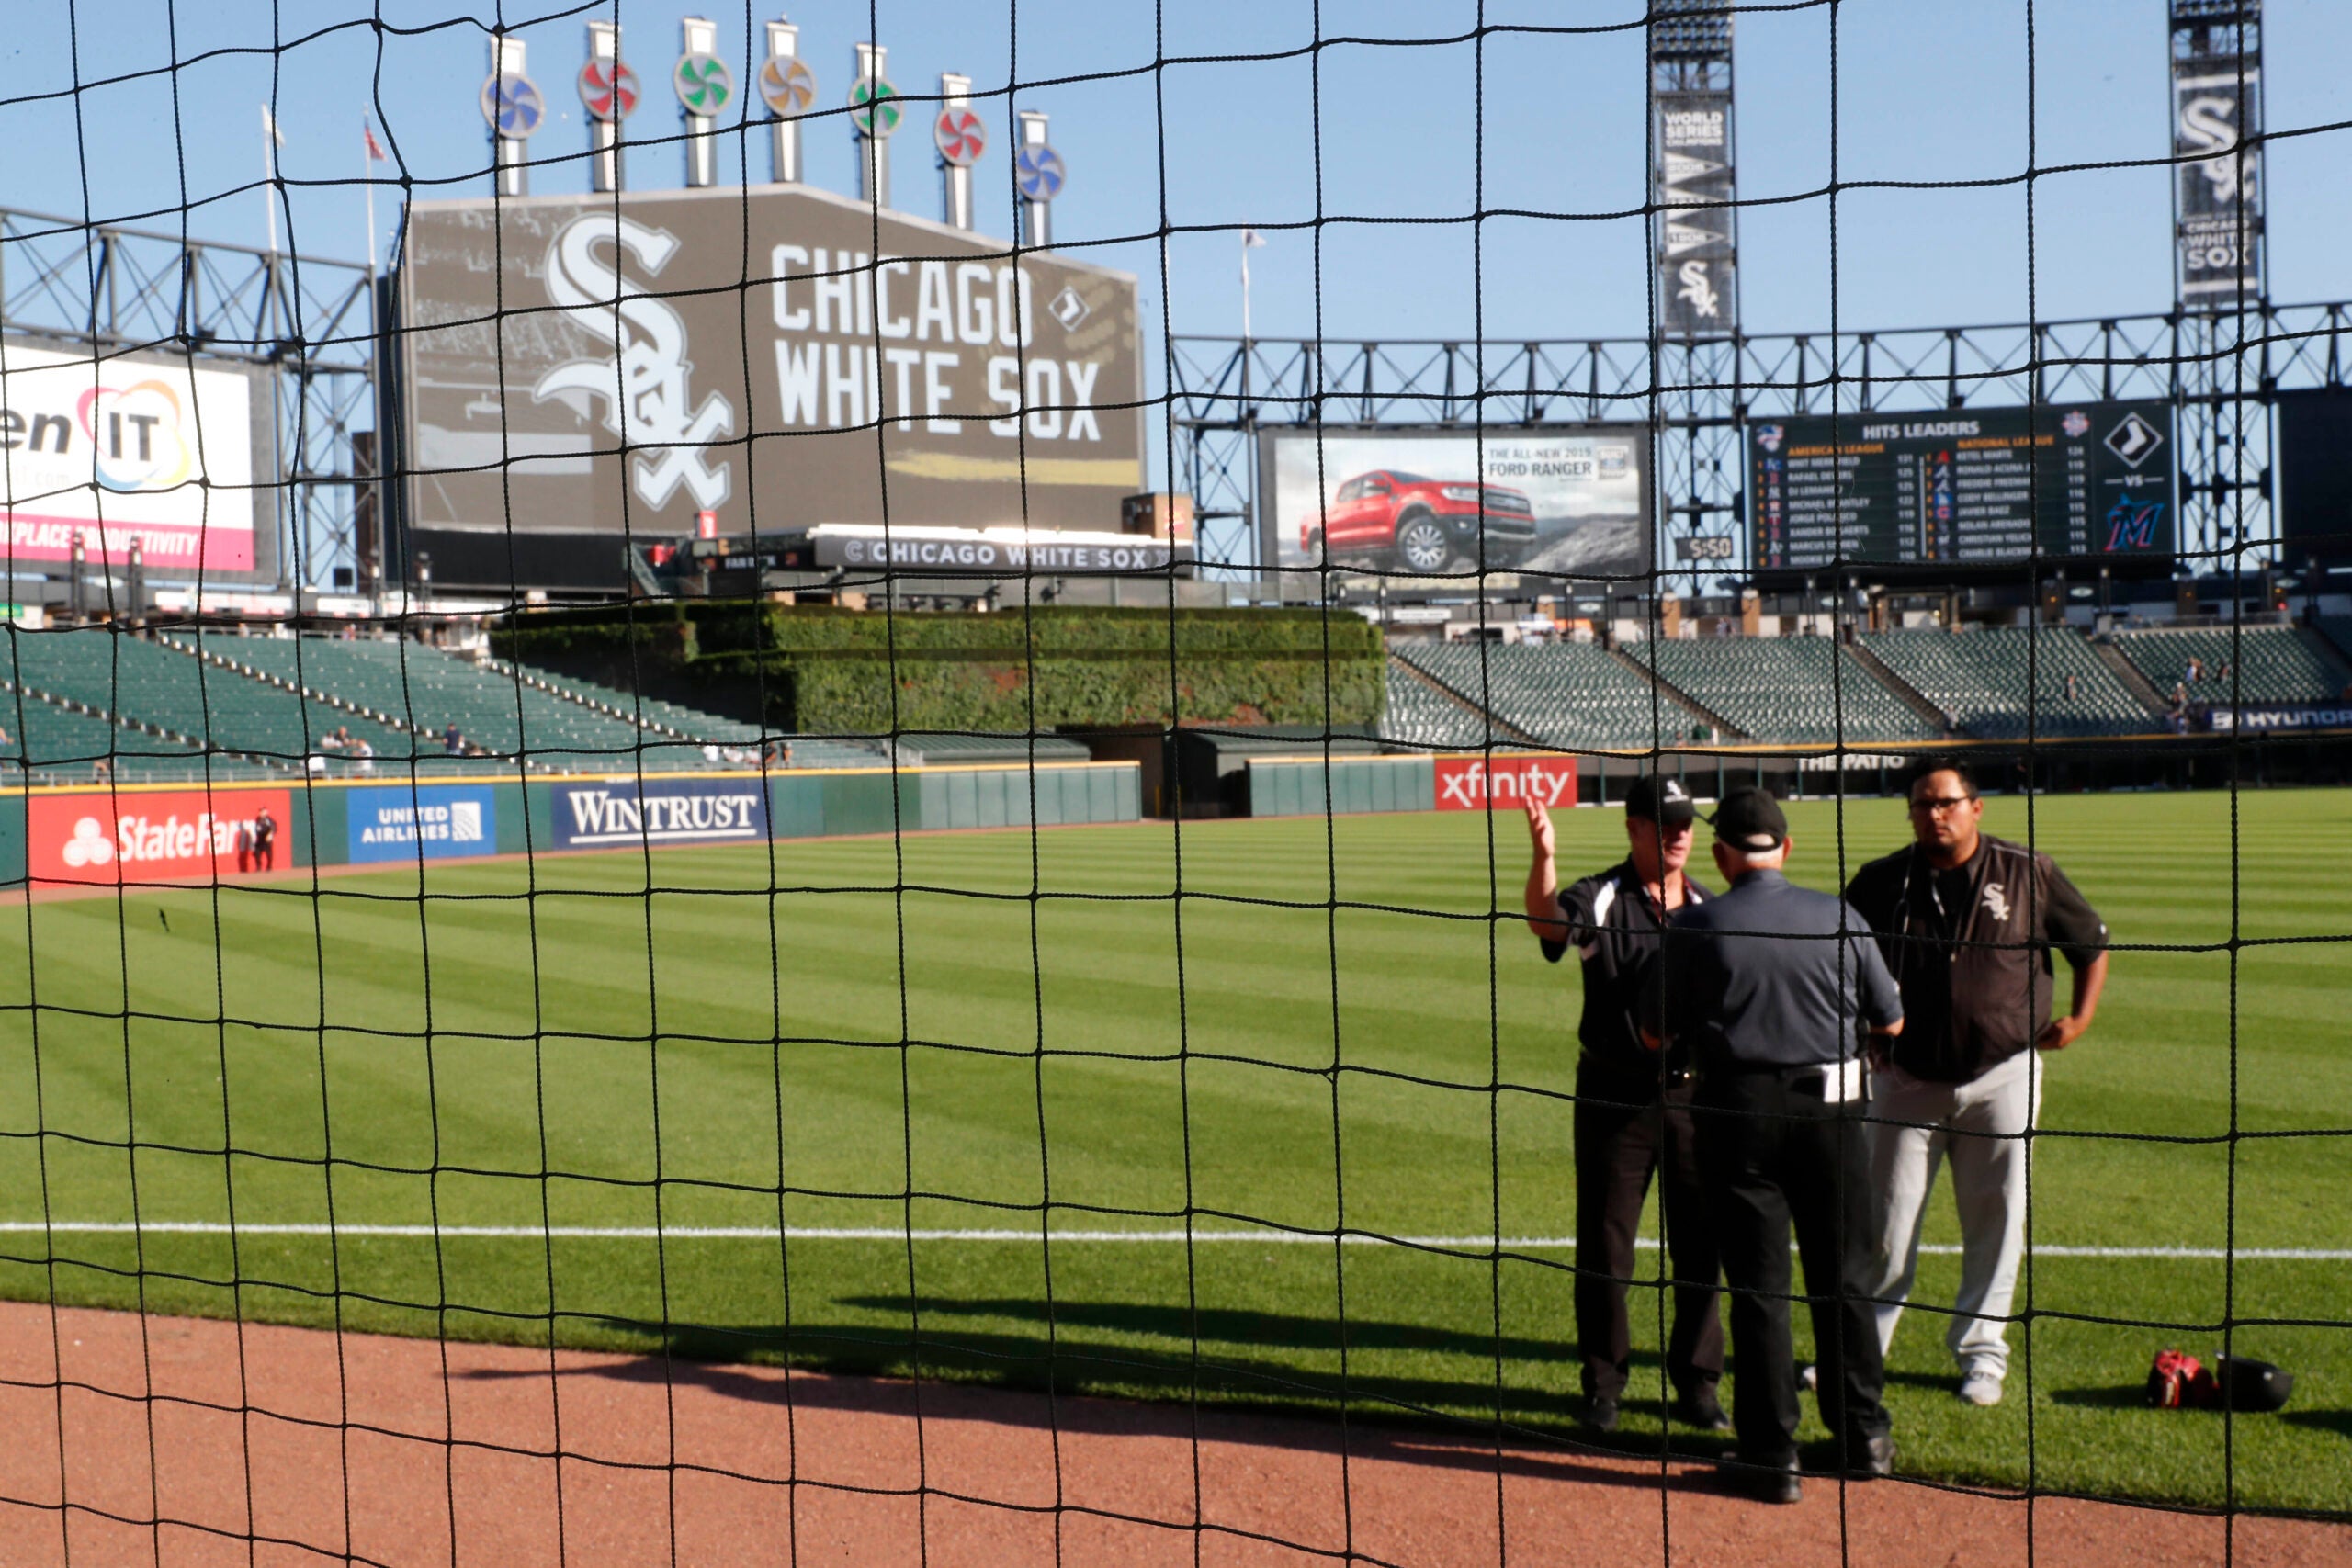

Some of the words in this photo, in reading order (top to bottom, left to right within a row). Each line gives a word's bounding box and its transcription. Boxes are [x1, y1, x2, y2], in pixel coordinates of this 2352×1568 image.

[1664, 111, 1723, 125] WORLD
[1665, 124, 1723, 138] SERIES
[2186, 220, 2249, 233] CHICAGO
[2188, 231, 2249, 246] WHITE
[2187, 246, 2249, 270] SOX
[772, 243, 1032, 348] CHICAGO
[775, 338, 962, 434] WHITE
[987, 355, 1101, 442] SOX
[109, 412, 159, 461] IT
[1862, 423, 1900, 440] HITS
[1903, 420, 1981, 438] LEADERS
[1787, 445, 1842, 457] AMERICAN
[1844, 443, 1885, 455] LEAGUE
[1957, 438, 2009, 449] NATIONAL
[2012, 434, 2054, 446] LEAGUE
[1489, 447, 1508, 459] THE
[1512, 447, 1560, 459] ALL-NEW
[1565, 446, 1591, 457] 2019
[1489, 462, 1527, 476] FORD
[1532, 461, 1591, 475] RANGER
[2124, 474, 2143, 487] VS
[872, 540, 995, 566] CHICAGO
[1005, 544, 1088, 567] WHITE
[1098, 547, 1147, 568] SOX
[1690, 538, 1731, 558] 5:50
[1796, 754, 1837, 772] THE
[1842, 753, 1905, 770] PATIO
[1442, 761, 1569, 807] xfinity
[379, 806, 448, 825] UNITED
[568, 790, 758, 834] WINTRUST
[361, 824, 449, 843] AIRLINES
